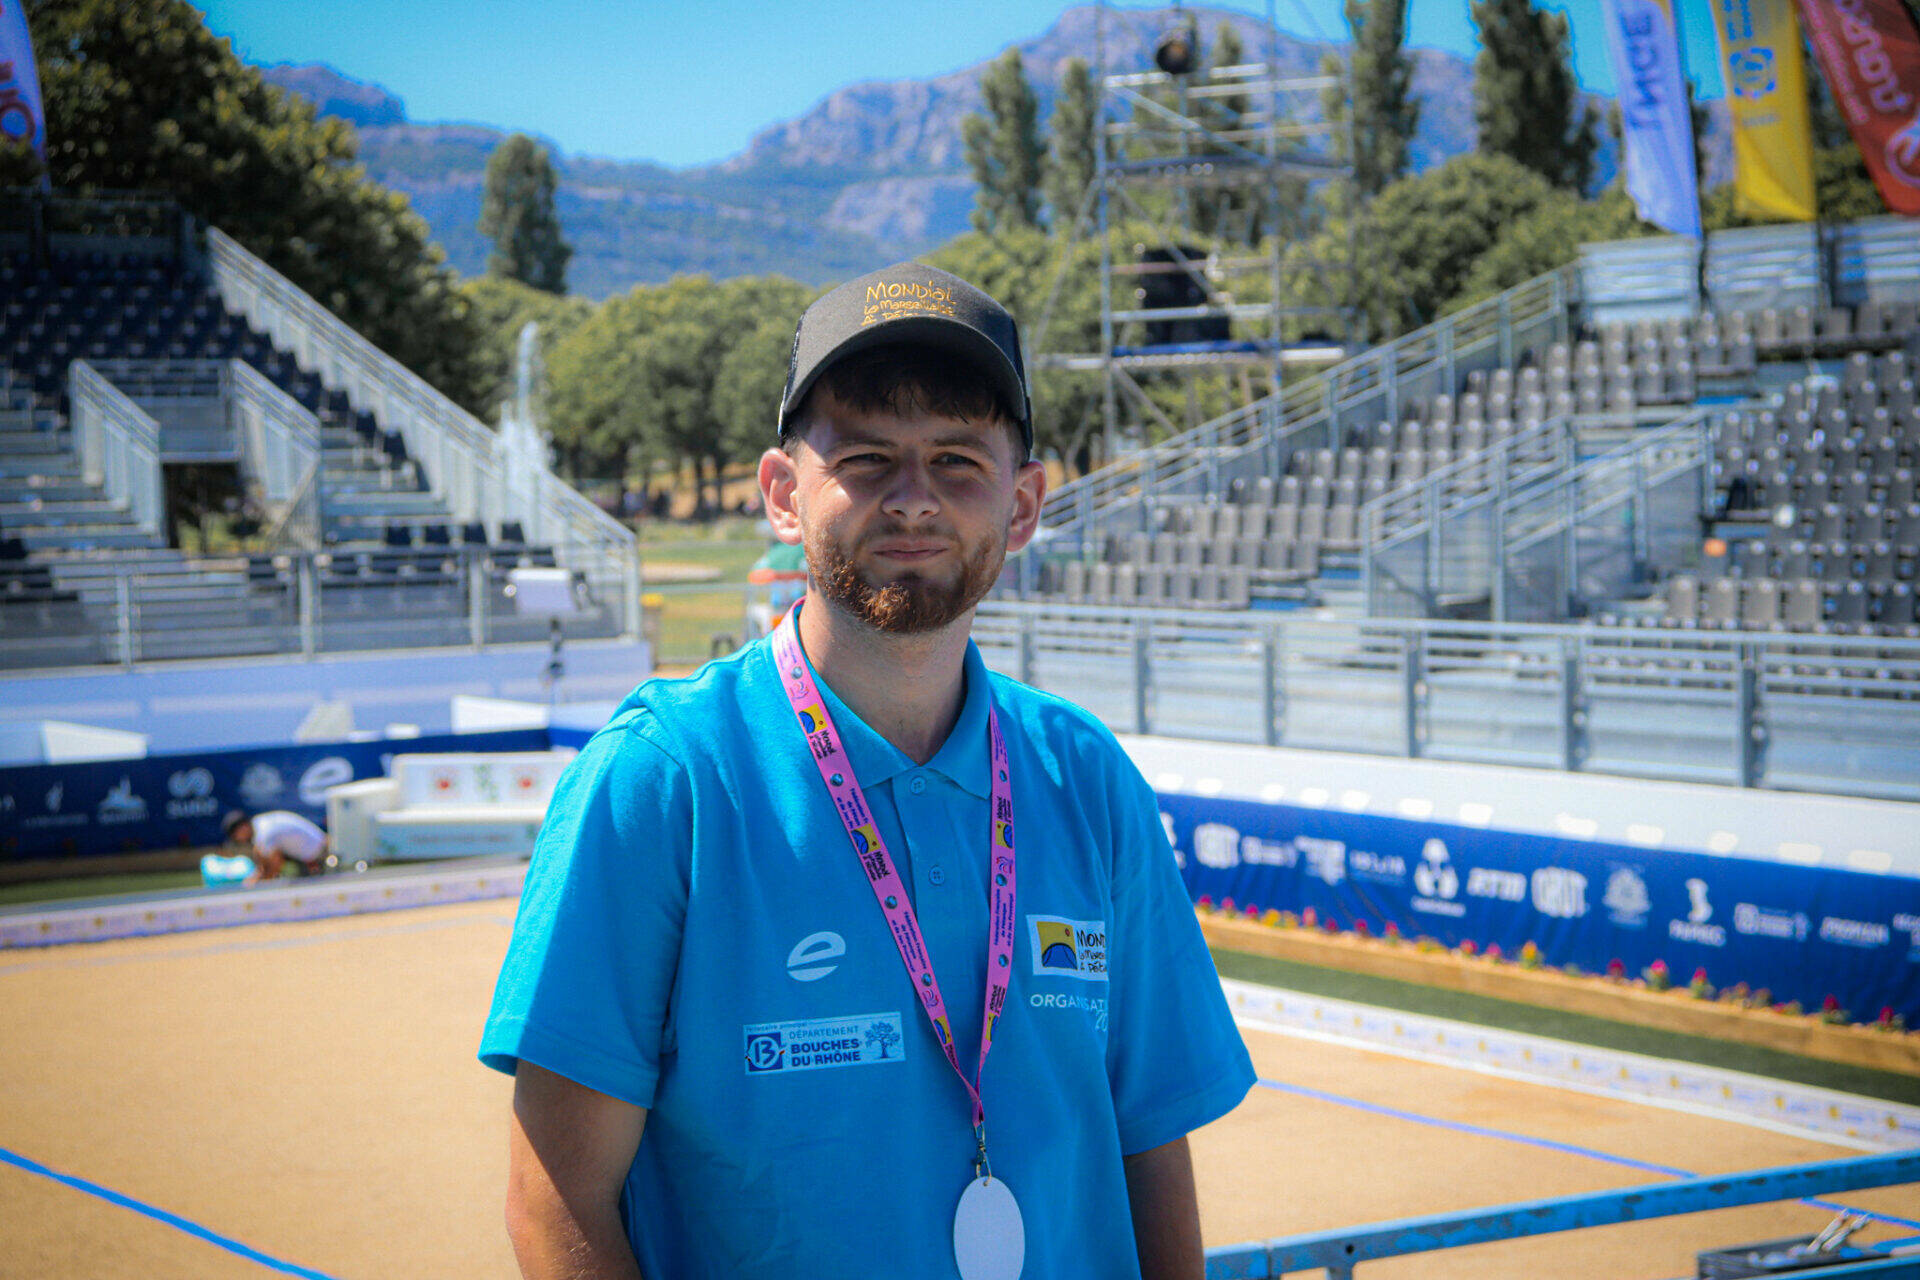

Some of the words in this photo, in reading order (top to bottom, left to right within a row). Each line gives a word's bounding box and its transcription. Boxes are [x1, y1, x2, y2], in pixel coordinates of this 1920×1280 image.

[789, 1025, 859, 1040] DÉPARTEMENT
[790, 1038, 860, 1054] BOUCHES
[791, 1055, 811, 1067] DU
[814, 1051, 861, 1065] RHÔNE
